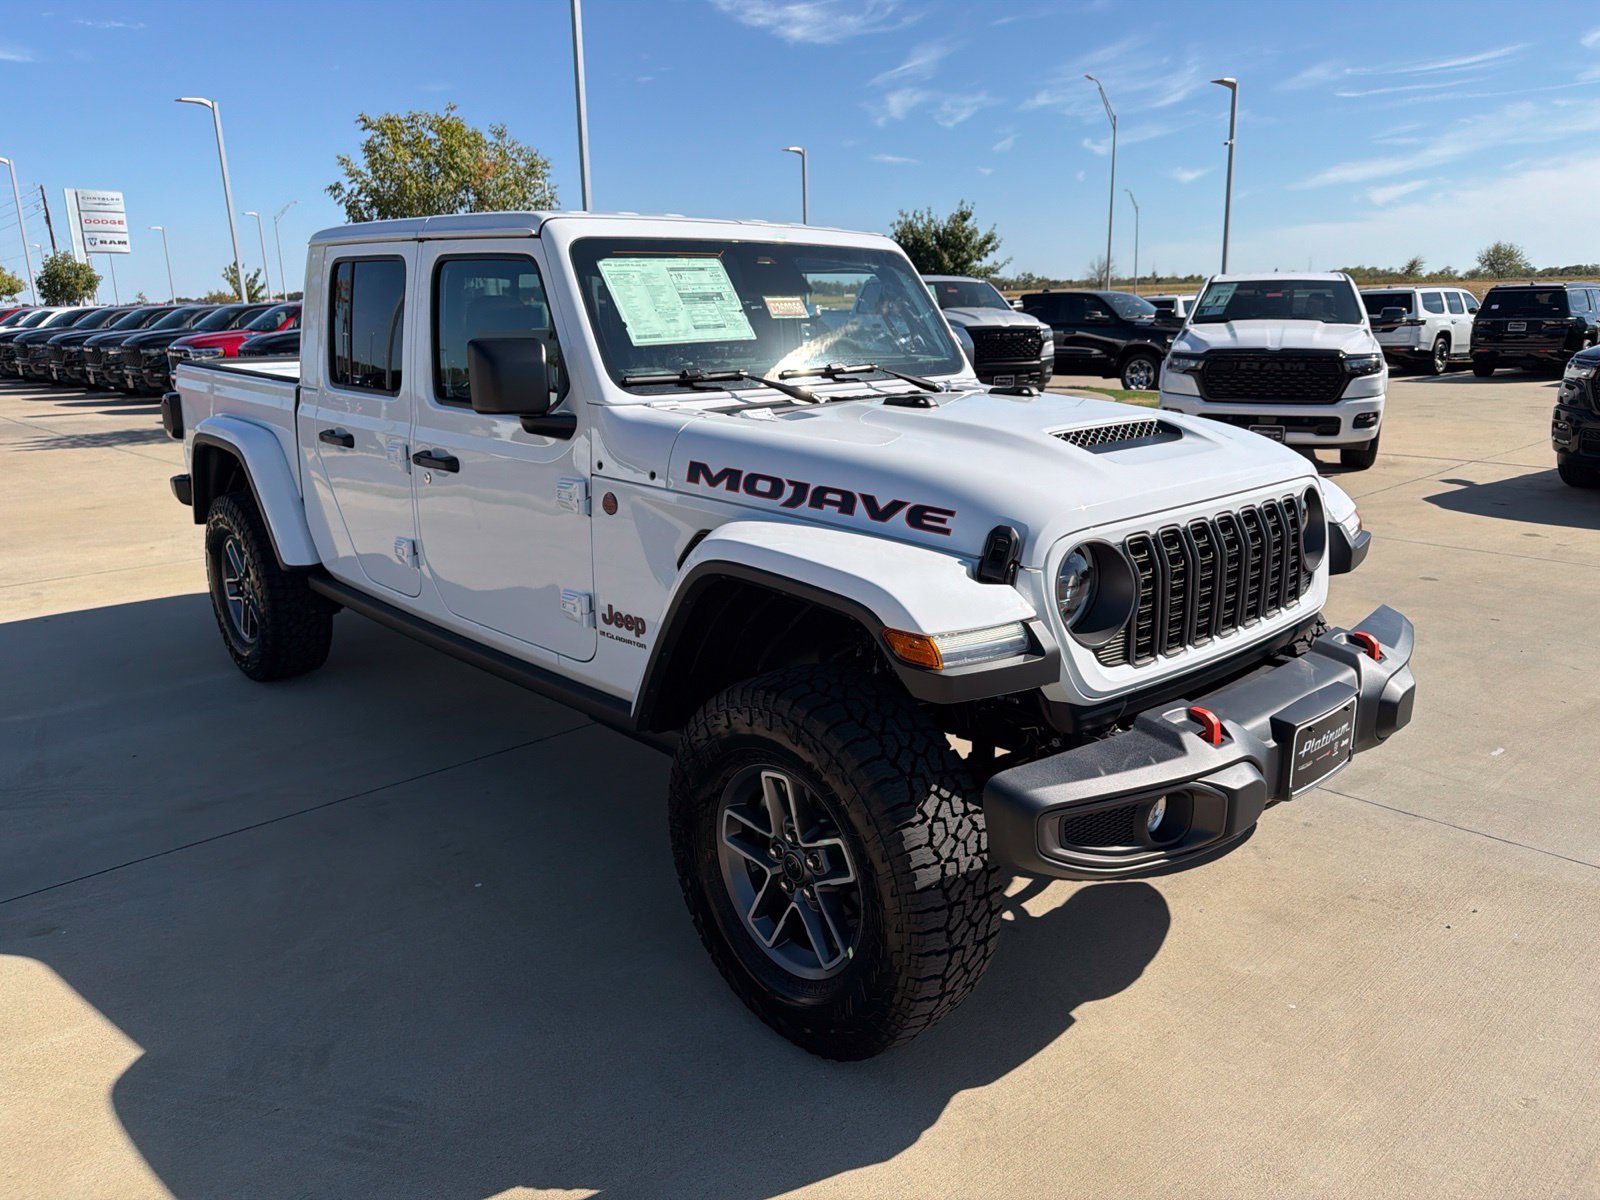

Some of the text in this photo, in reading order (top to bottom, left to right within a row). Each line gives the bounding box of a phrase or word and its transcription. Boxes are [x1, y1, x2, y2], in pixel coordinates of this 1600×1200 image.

[686, 460, 957, 537] MOJAVE
[601, 604, 647, 638] Jeep
[606, 632, 647, 650] GLADIATOR
[1298, 722, 1350, 758] Platinum
